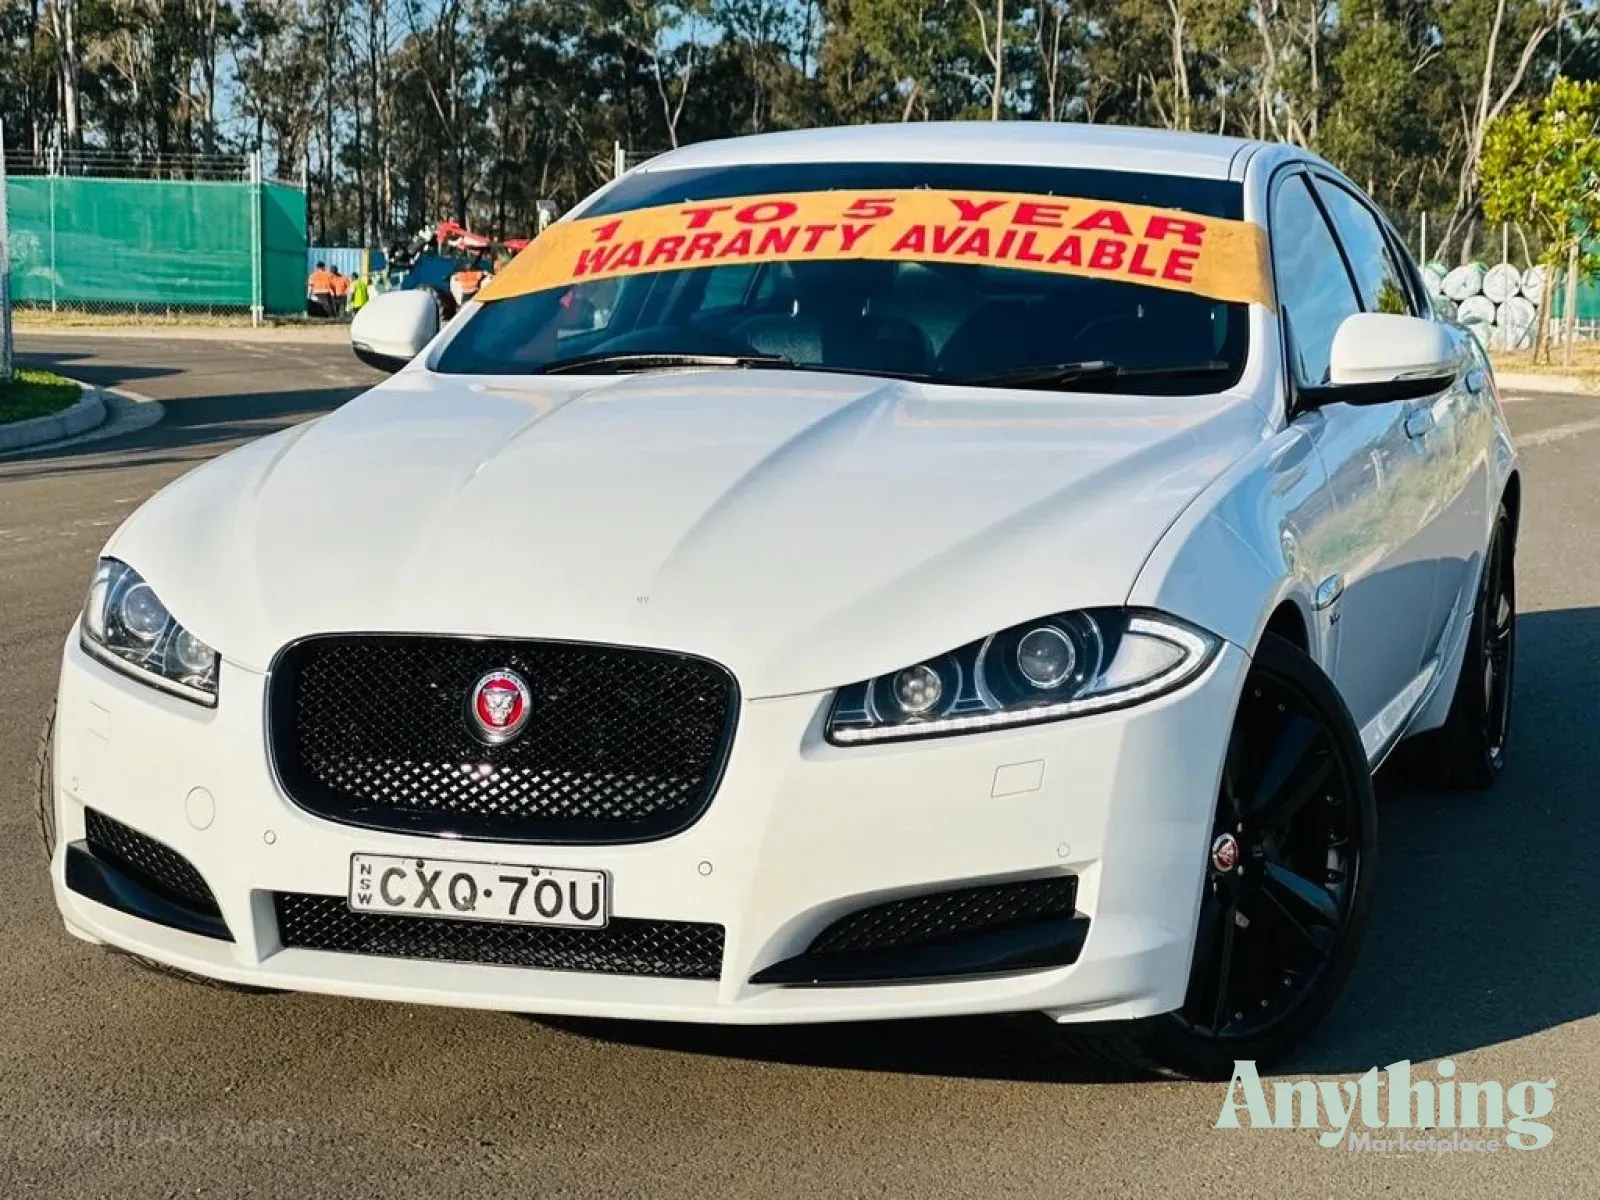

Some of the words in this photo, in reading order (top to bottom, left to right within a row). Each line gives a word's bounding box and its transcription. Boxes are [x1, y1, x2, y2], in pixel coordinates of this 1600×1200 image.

[592, 220, 621, 243] 1
[681, 200, 800, 230] TO
[844, 199, 894, 221] 5
[949, 198, 1207, 247] YEAR
[573, 223, 875, 278] WARRANTY
[890, 223, 1200, 285] AVAILABLE
